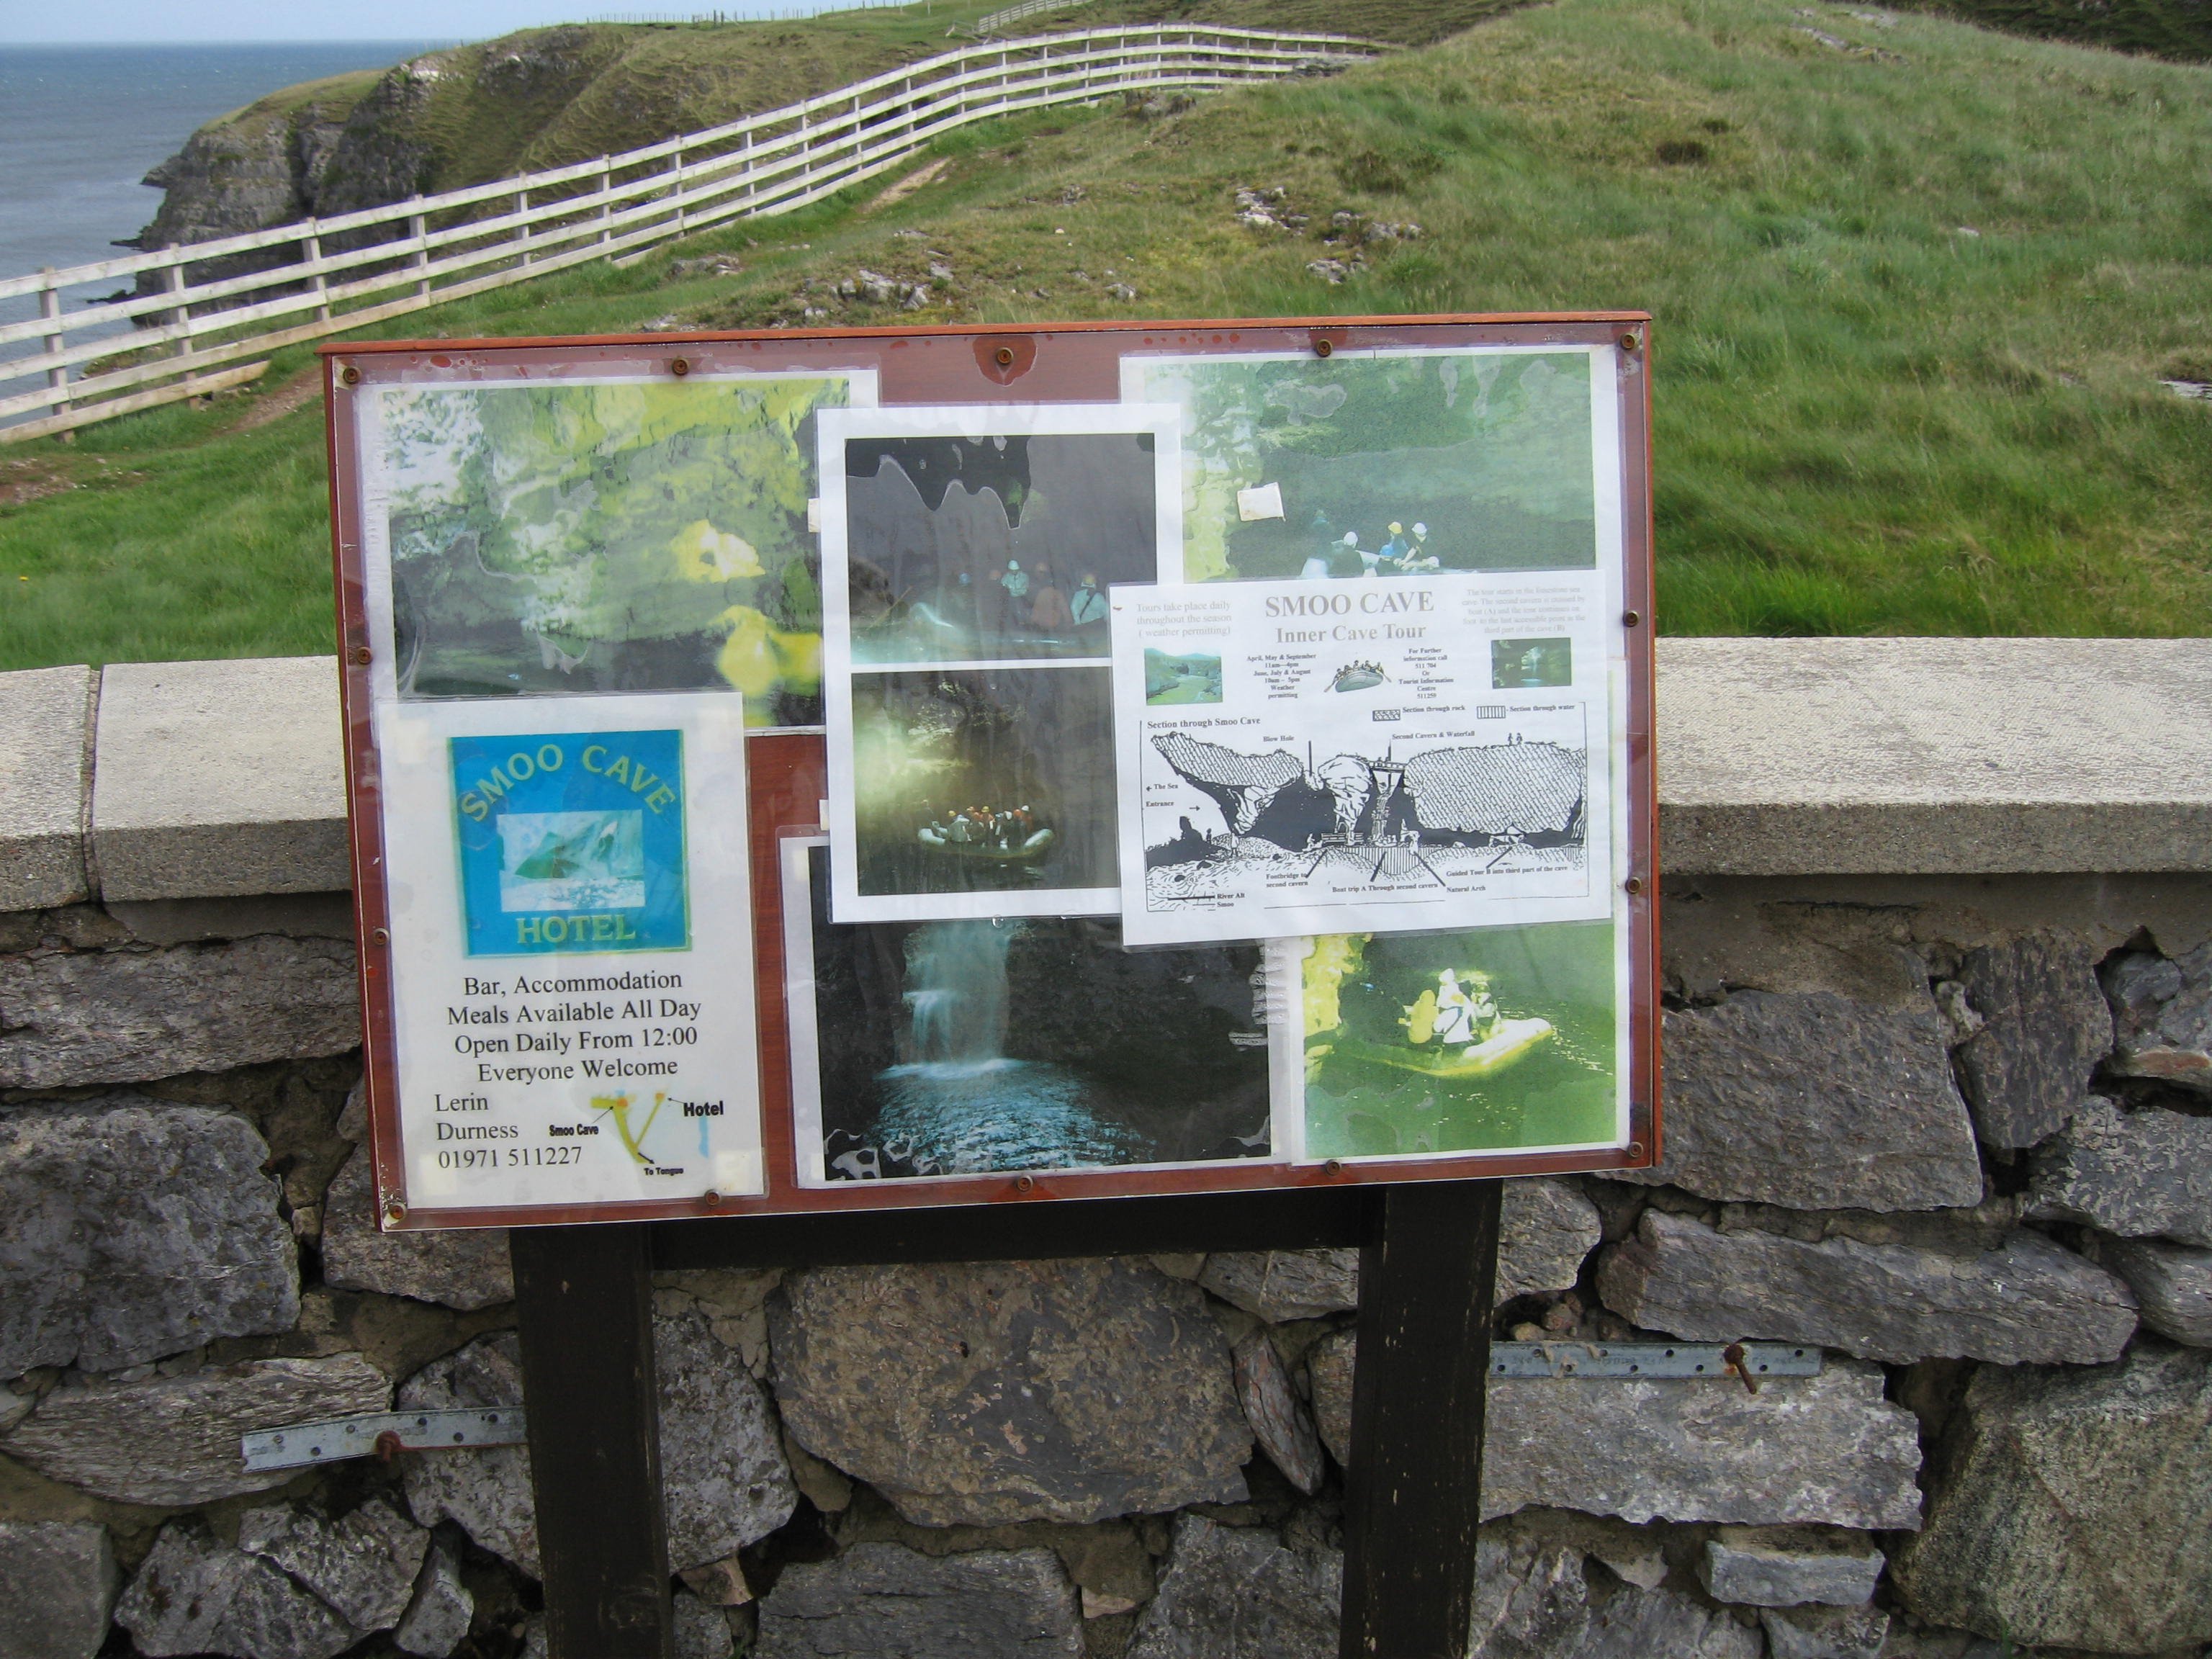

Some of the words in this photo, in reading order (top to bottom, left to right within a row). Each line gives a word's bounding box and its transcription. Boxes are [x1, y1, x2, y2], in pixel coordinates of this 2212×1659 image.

[1136, 603, 1161, 612] Tours
[1164, 602, 1181, 611] take
[1184, 602, 1207, 613] place
[1210, 601, 1231, 611] daily
[1265, 594, 1352, 617] SMOO
[1360, 591, 1434, 614] CAVE
[1137, 615, 1184, 626] throughout
[1145, 628, 1178, 637] weather
[1182, 626, 1231, 637] permitting)
[1275, 628, 1326, 643] Inner
[1332, 625, 1377, 641] Cave
[1382, 623, 1426, 639] Tour
[1147, 720, 1177, 729] Section
[1180, 719, 1213, 728] through
[1240, 716, 1261, 725] Cave
[461, 744, 564, 822] SMOO
[582, 745, 677, 814] CAVE
[516, 914, 637, 944] HOTEL
[464, 976, 506, 997] Bar,
[514, 970, 683, 994] Accommodation
[447, 1005, 509, 1025] Meals
[516, 1000, 614, 1023] Available
[621, 999, 652, 1019] All
[660, 998, 701, 1021] Day
[454, 1035, 509, 1058] Open
[516, 1032, 572, 1055] Daily
[578, 1030, 633, 1050] From
[642, 1027, 698, 1046] 12:00
[477, 1064, 575, 1085] Everyone
[581, 1058, 678, 1078] Welcome
[435, 1092, 489, 1112] Lerin
[683, 1101, 724, 1117] Hotel
[436, 1123, 518, 1141] Durness
[549, 1124, 574, 1136] Smoo
[577, 1123, 599, 1136] Cave
[439, 1149, 498, 1169] 01971
[508, 1146, 582, 1166] 511227
[644, 1167, 654, 1176] To
